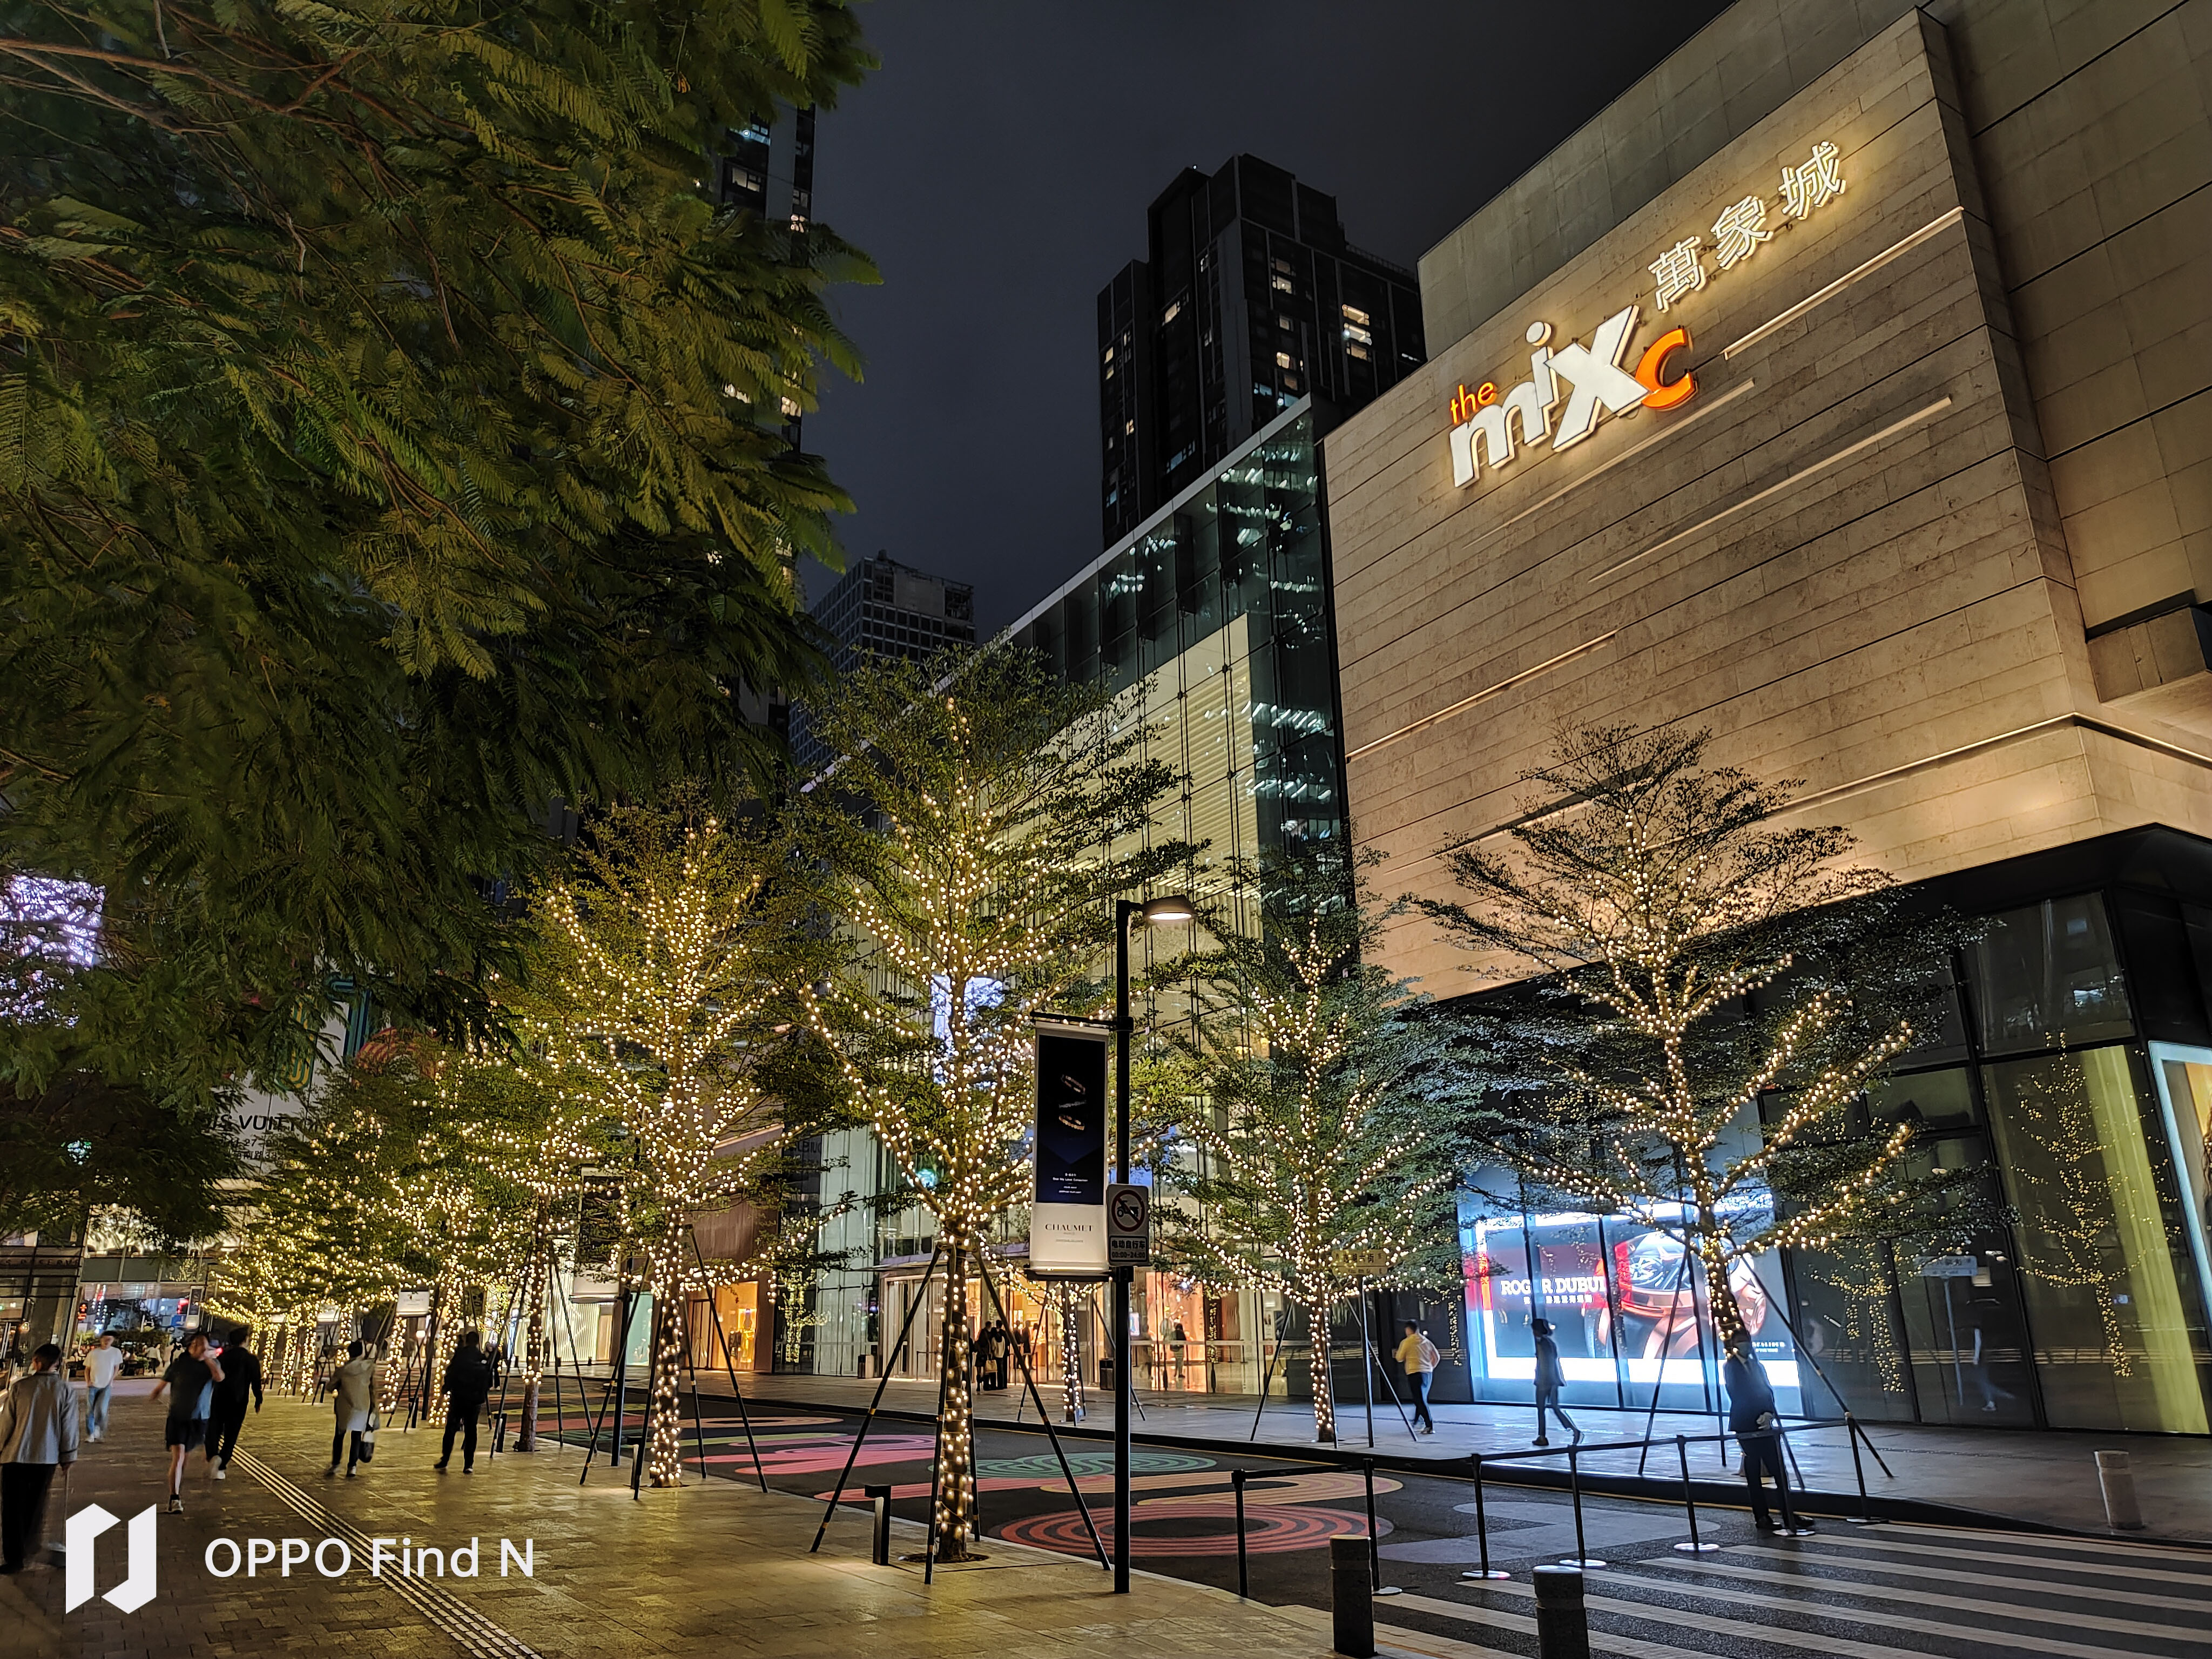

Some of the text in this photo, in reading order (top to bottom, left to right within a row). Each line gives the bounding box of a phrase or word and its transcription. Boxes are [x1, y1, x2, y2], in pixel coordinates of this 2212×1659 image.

[1648, 140, 1846, 312] 萬象城
[1450, 382, 1497, 424] the
[1045, 1223, 1093, 1232] CHAUMET
[1500, 1276, 1608, 1295] ROGR DUBUI
